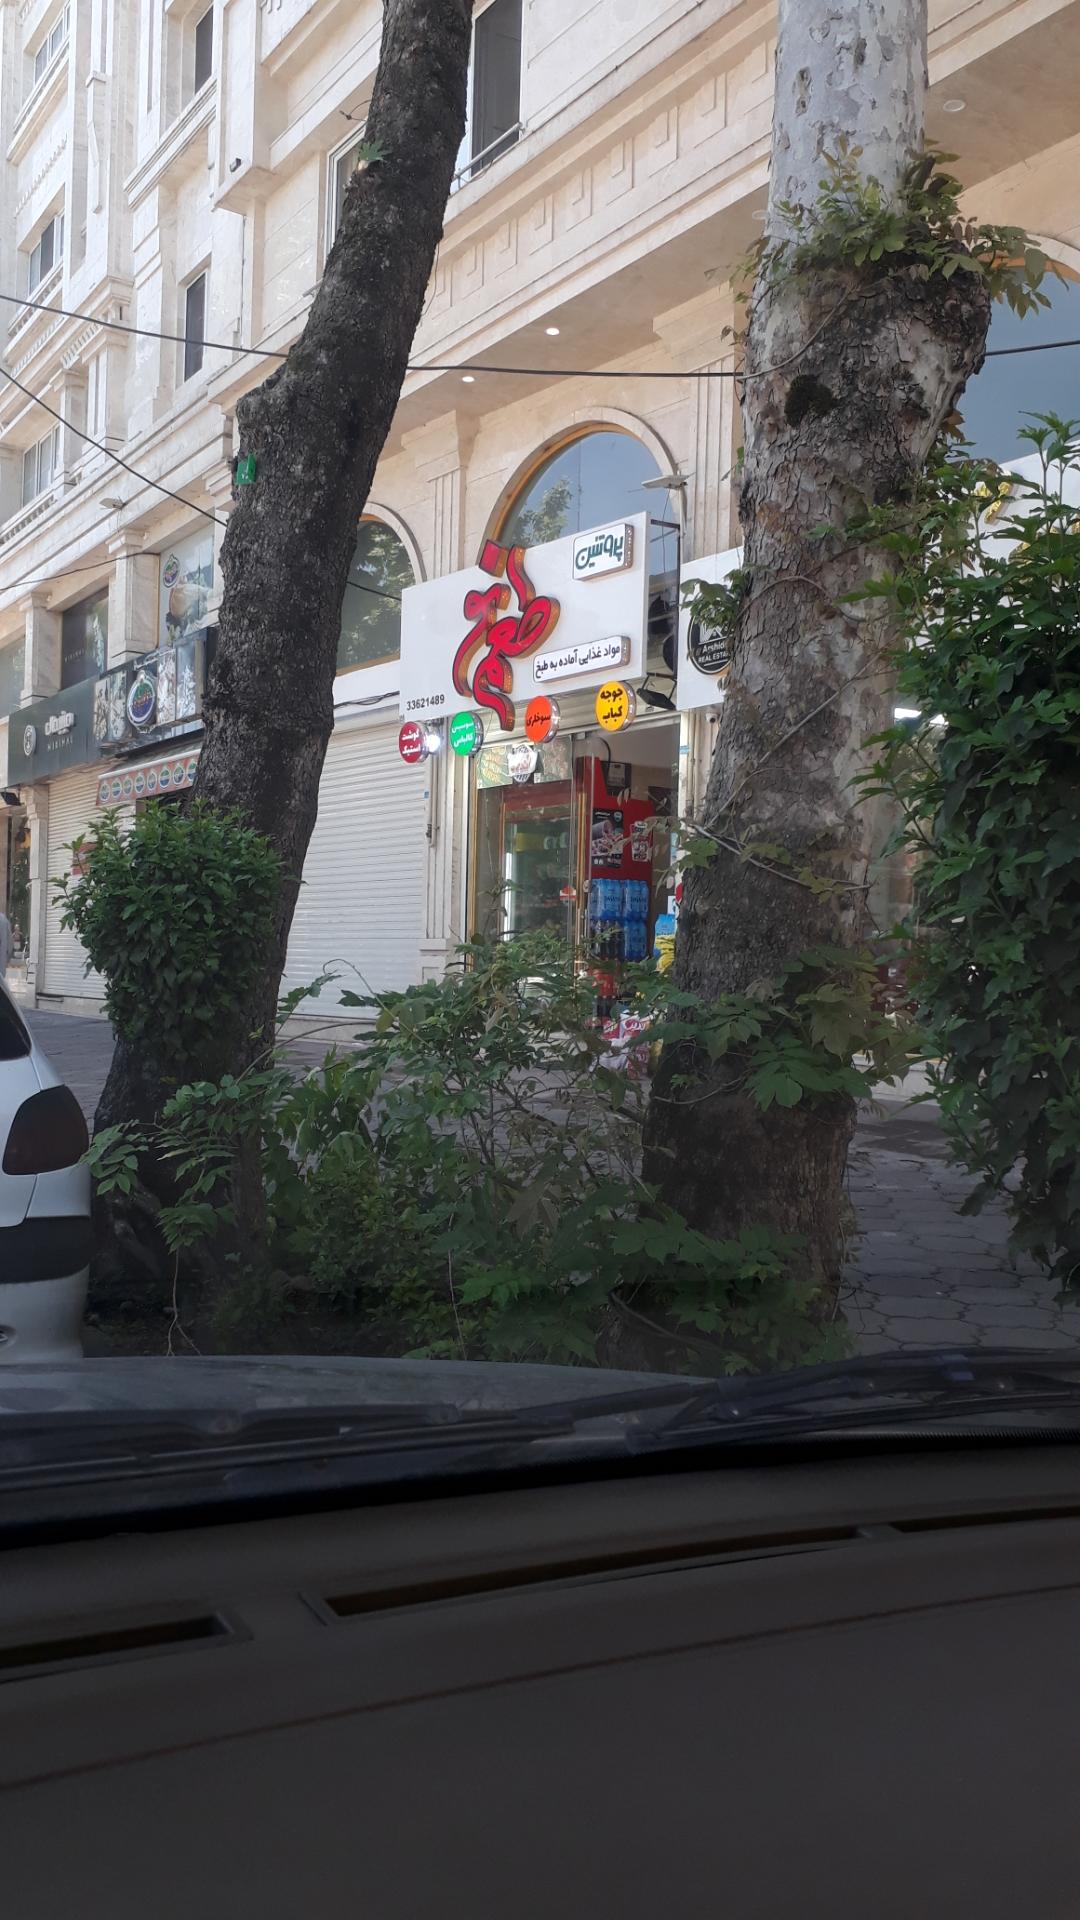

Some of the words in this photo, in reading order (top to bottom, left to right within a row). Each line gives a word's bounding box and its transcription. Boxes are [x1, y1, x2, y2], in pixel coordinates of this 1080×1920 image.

[603, 644, 620, 659] مواد
[702, 641, 726, 653] Arshid
[558, 648, 578, 667] آماده
[578, 646, 603, 666] غذایی
[535, 659, 549, 679] طبخ
[549, 660, 558, 671] به
[600, 687, 623, 702] جوجه
[406, 694, 445, 711] 33621489
[526, 712, 551, 727] سوخاری
[602, 705, 623, 724] کباب
[401, 728, 420, 742] گوشت
[451, 721, 474, 734] سوسیس
[453, 732, 474, 747] کالباس
[402, 743, 421, 756] استیک
